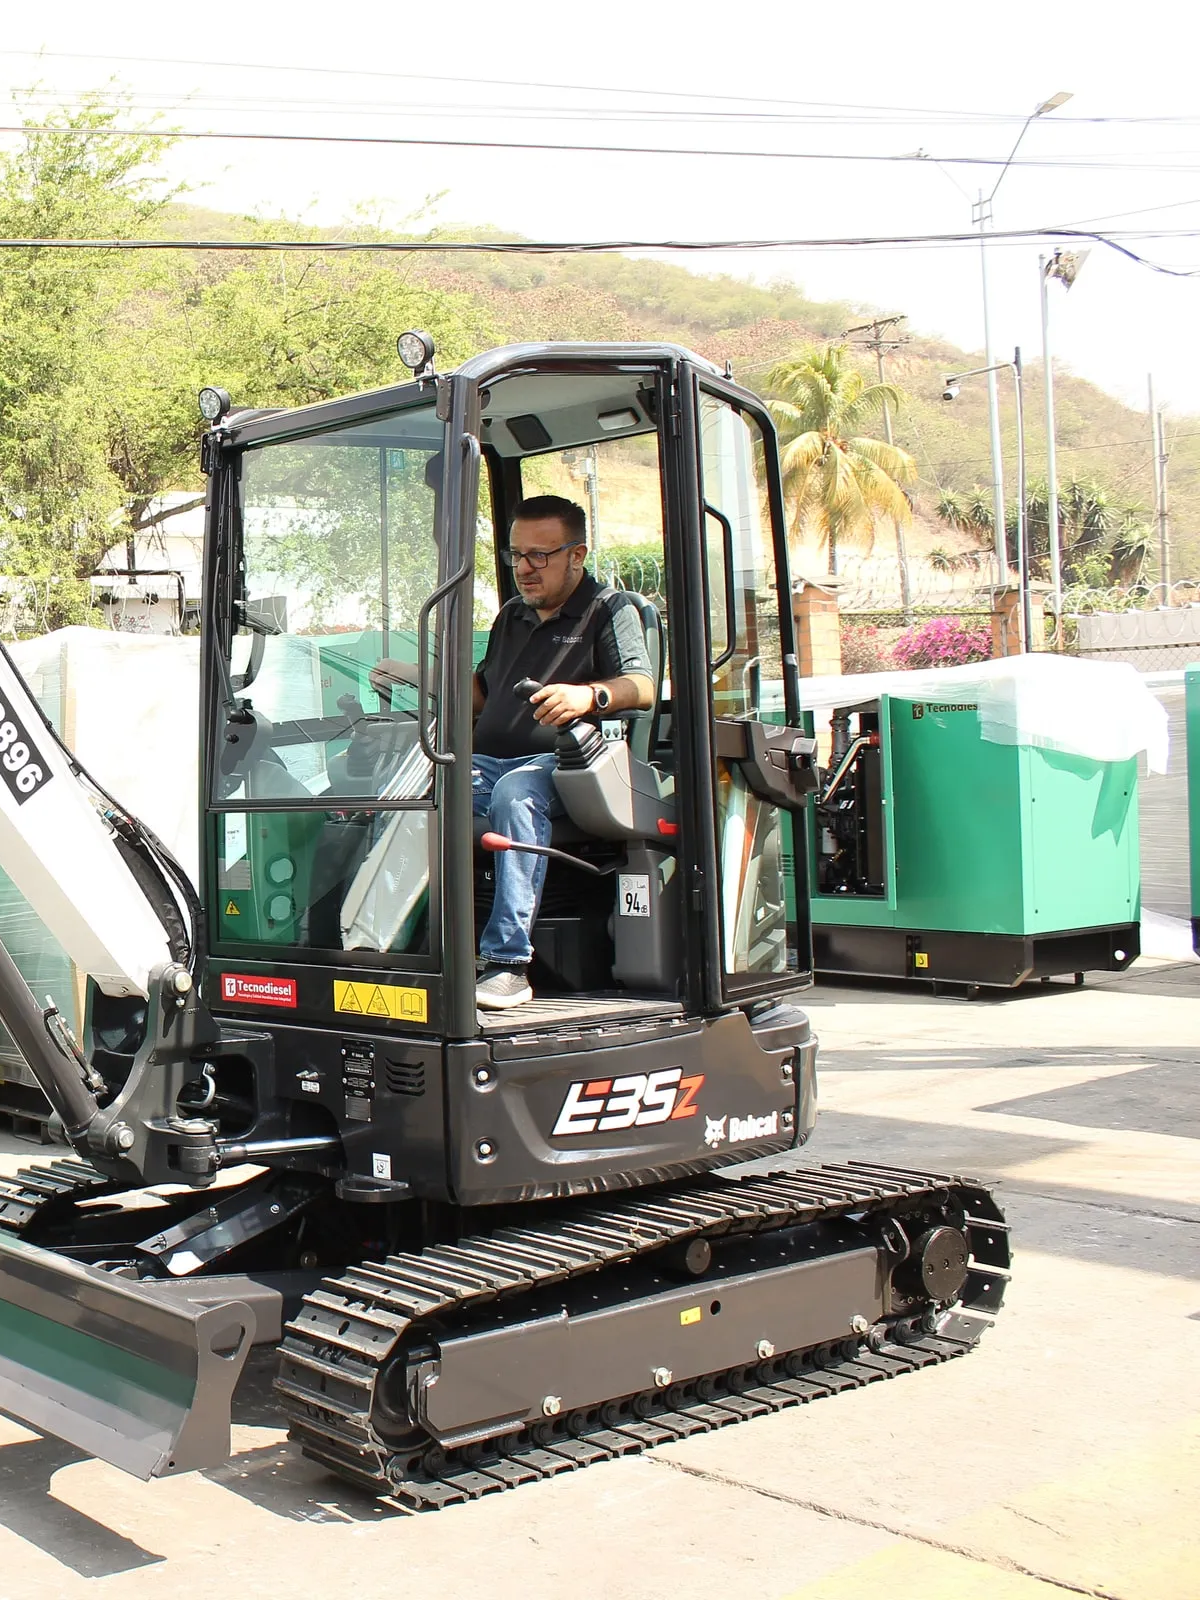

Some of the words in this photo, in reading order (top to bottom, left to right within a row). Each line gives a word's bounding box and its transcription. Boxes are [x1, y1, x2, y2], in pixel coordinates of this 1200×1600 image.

[625, 892, 641, 913] 94
[236, 979, 292, 996] Tecnodiesel
[728, 1110, 778, 1143] Bobcat
